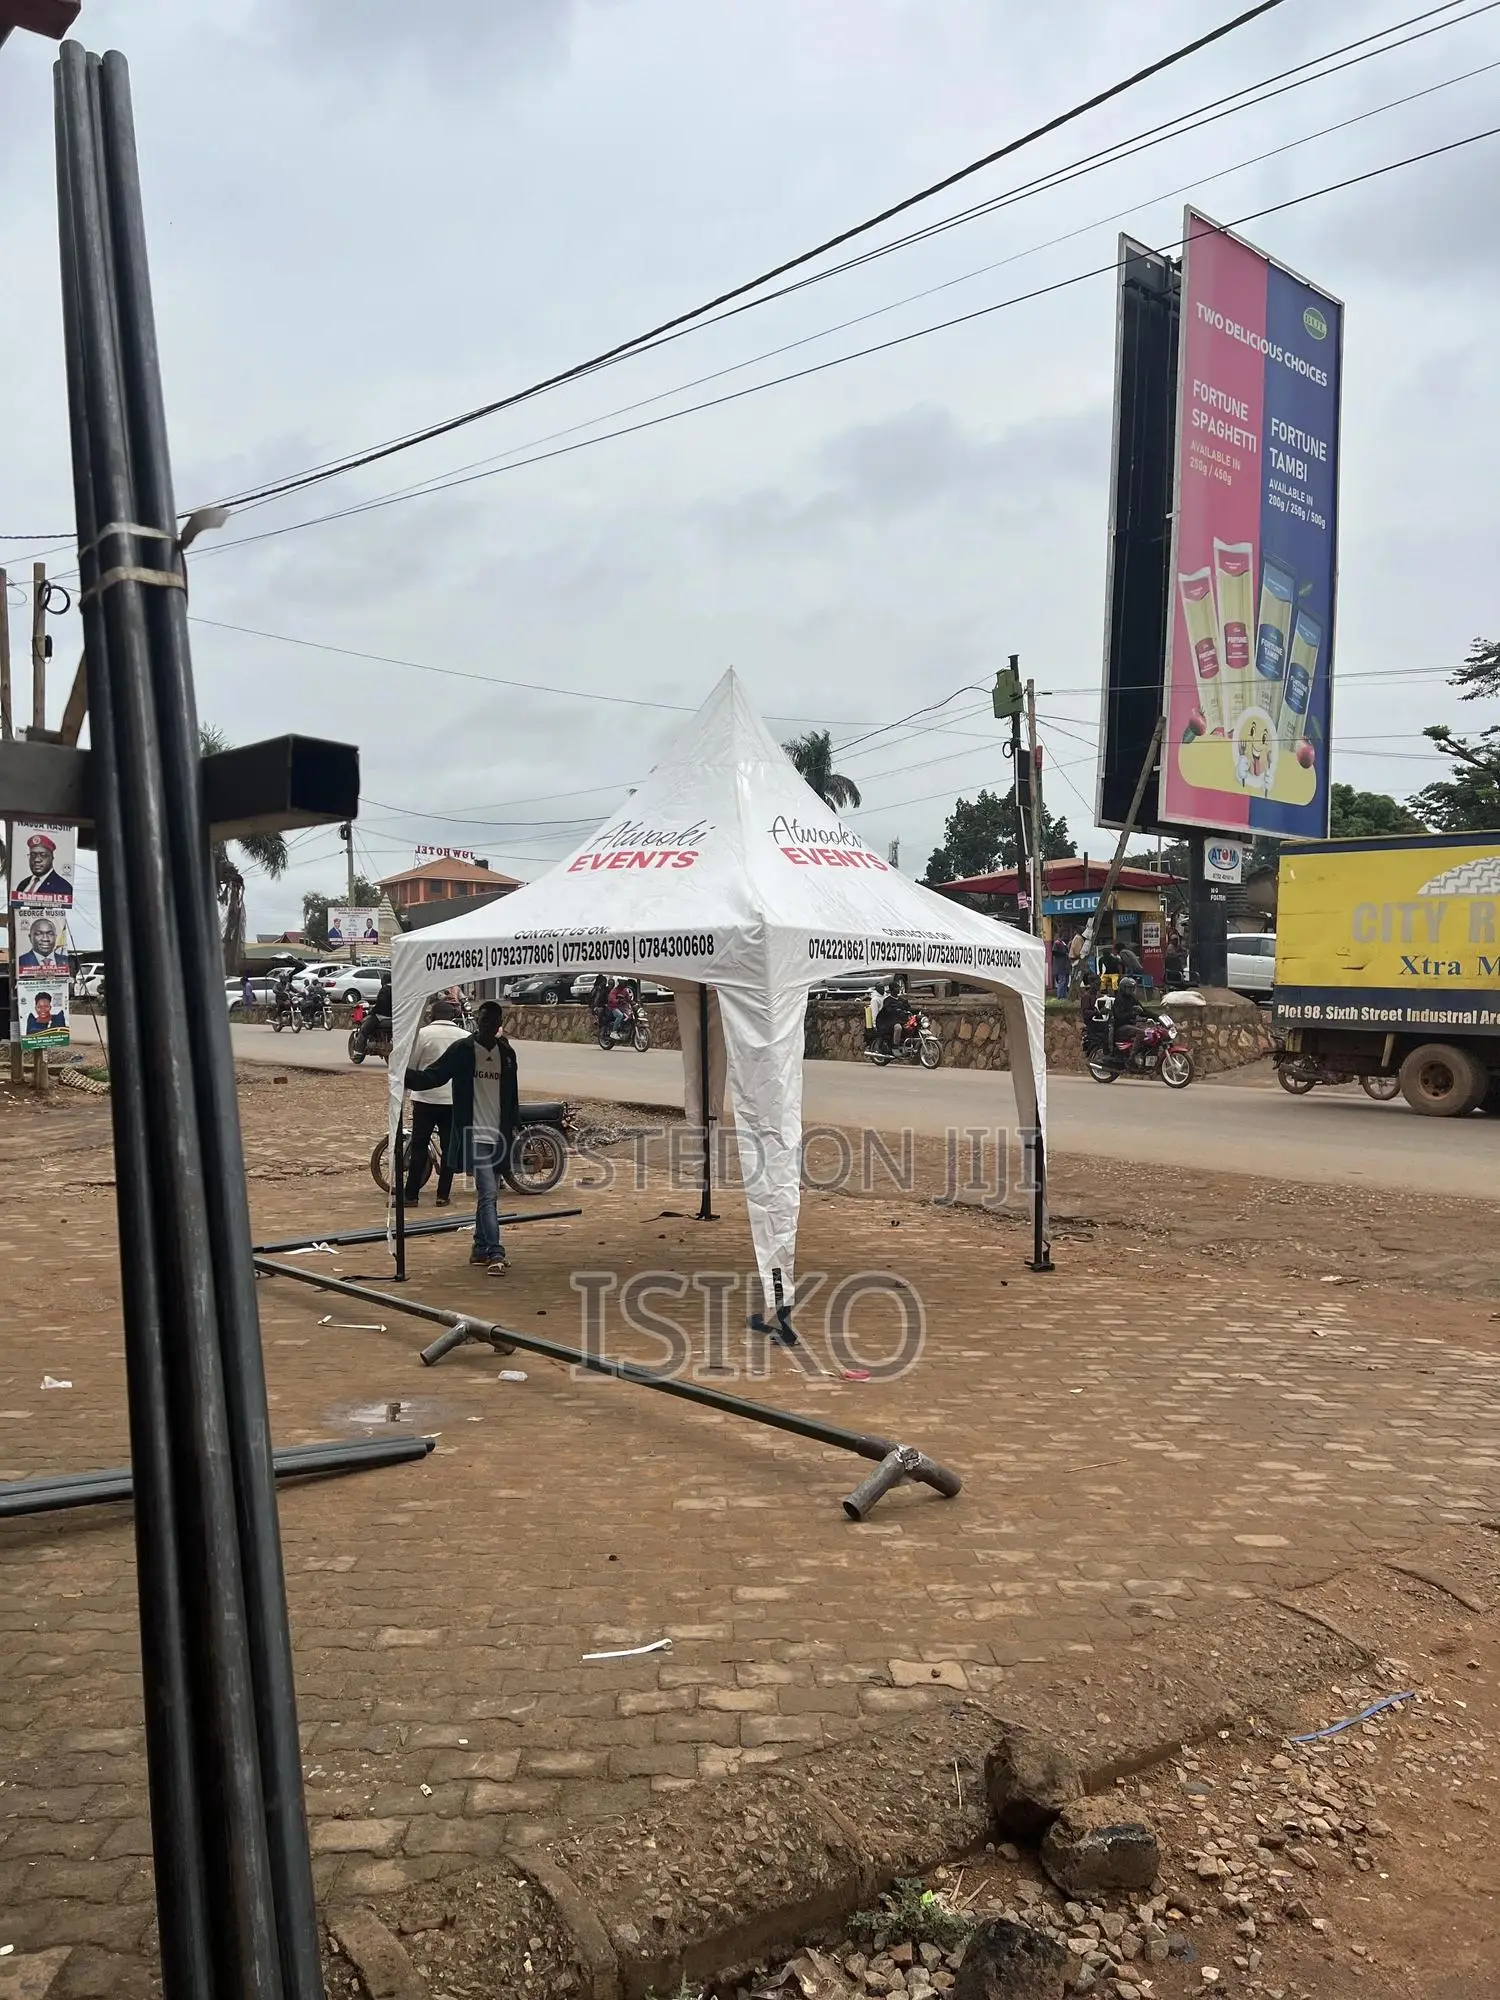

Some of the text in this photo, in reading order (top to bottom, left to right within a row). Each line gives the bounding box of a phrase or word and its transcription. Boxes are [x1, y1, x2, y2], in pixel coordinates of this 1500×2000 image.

[1196, 302, 1224, 330] TWO
[1225, 318, 1283, 362] DELICIOUS
[1284, 351, 1328, 387] CHOICES
[1193, 379, 1249, 422] FORTUNE
[1191, 408, 1257, 453] SPAGHETTI
[1271, 417, 1327, 462] FORTUNE
[1190, 440, 1241, 471] AVAILABLE IN
[1269, 447, 1308, 482] TAMBI
[1190, 457, 1208, 476] 250g
[1214, 467, 1232, 486] 450g
[1268, 478, 1313, 507] AVAILABLE IN
[1268, 494, 1285, 512] 200g
[1290, 502, 1306, 521] 250g
[1311, 512, 1326, 530] 500g
[567, 850, 699, 873] EVENTS
[779, 847, 888, 872] EVENTS
[514, 928, 571, 940] CONTACT
[569, 927, 589, 936] US
[1352, 901, 1448, 944] CITY
[426, 934, 714, 971] 0742221862 0792377806 0775280709 0784300608
[808, 938, 864, 960] 0742221862
[870, 941, 921, 962] 0792377806
[927, 944, 972, 965] 0775280709
[1399, 955, 1462, 976] Xtra
[1277, 1004, 1302, 1018] Plot
[1304, 1005, 1323, 1020] 98,
[1325, 1006, 1358, 1020] Sixth
[1361, 1006, 1403, 1021] Street
[1406, 1008, 1477, 1024] Industrial
